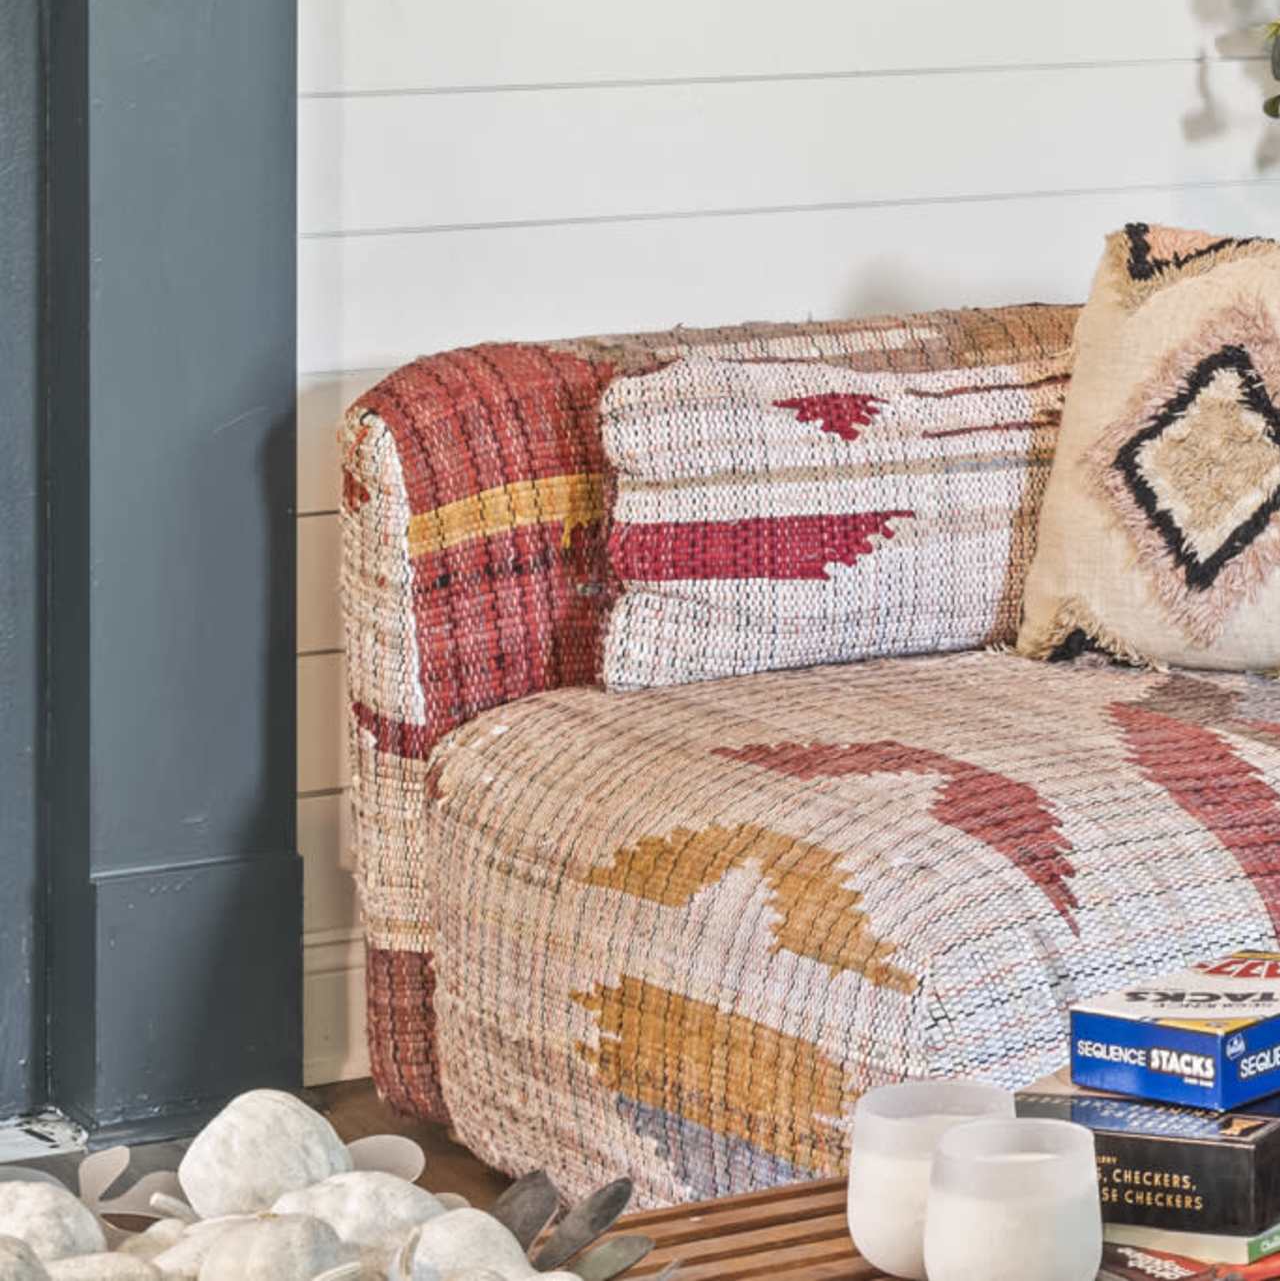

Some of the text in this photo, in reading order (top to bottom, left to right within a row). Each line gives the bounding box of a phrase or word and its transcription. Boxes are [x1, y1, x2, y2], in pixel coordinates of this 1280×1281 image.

[1077, 1039, 1215, 1079] SEQUENCE STACKS
[1112, 1169, 1197, 1191] CHECKERS,
[1124, 1190, 1203, 1210] CHECKERS
